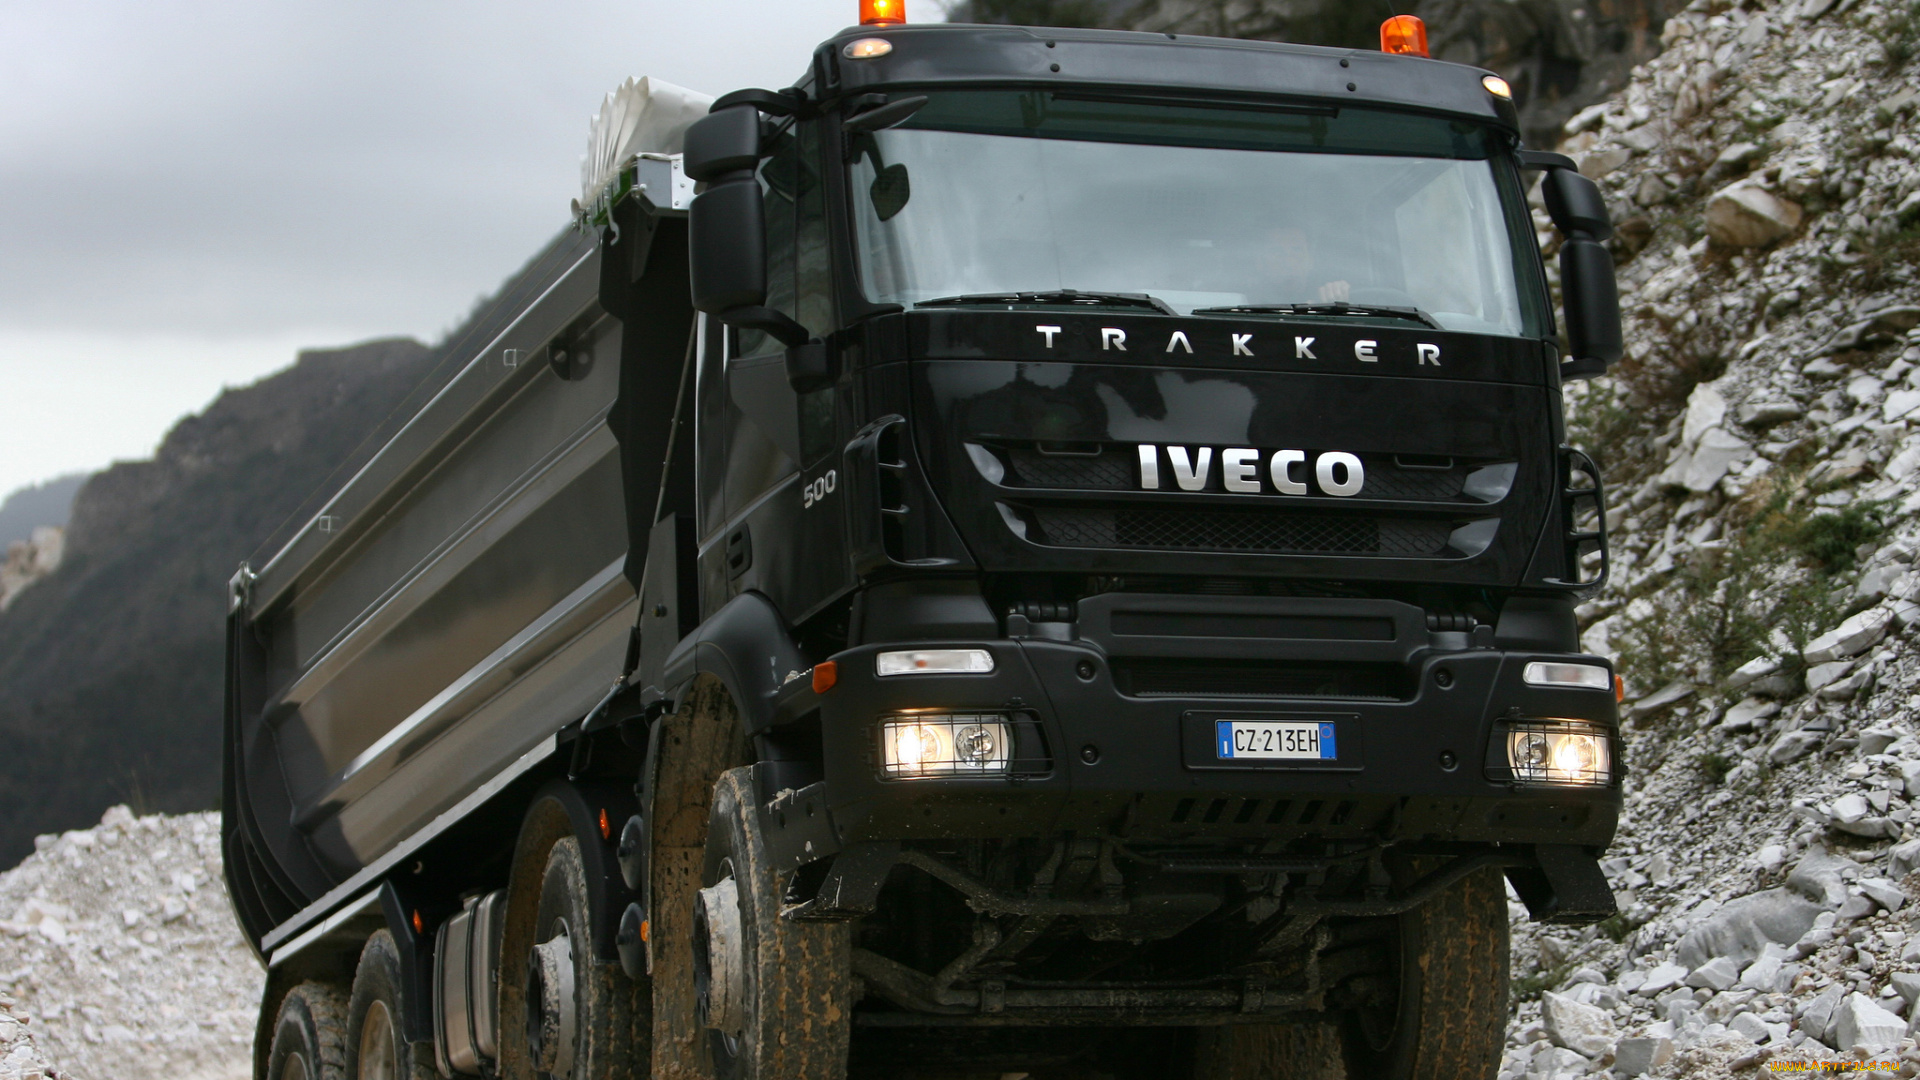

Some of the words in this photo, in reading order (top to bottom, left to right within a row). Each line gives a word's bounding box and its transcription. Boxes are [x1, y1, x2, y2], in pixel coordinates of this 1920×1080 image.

[1036, 325, 1441, 366] TRAKKER
[803, 469, 836, 509] 500
[1138, 444, 1364, 497] IVECO
